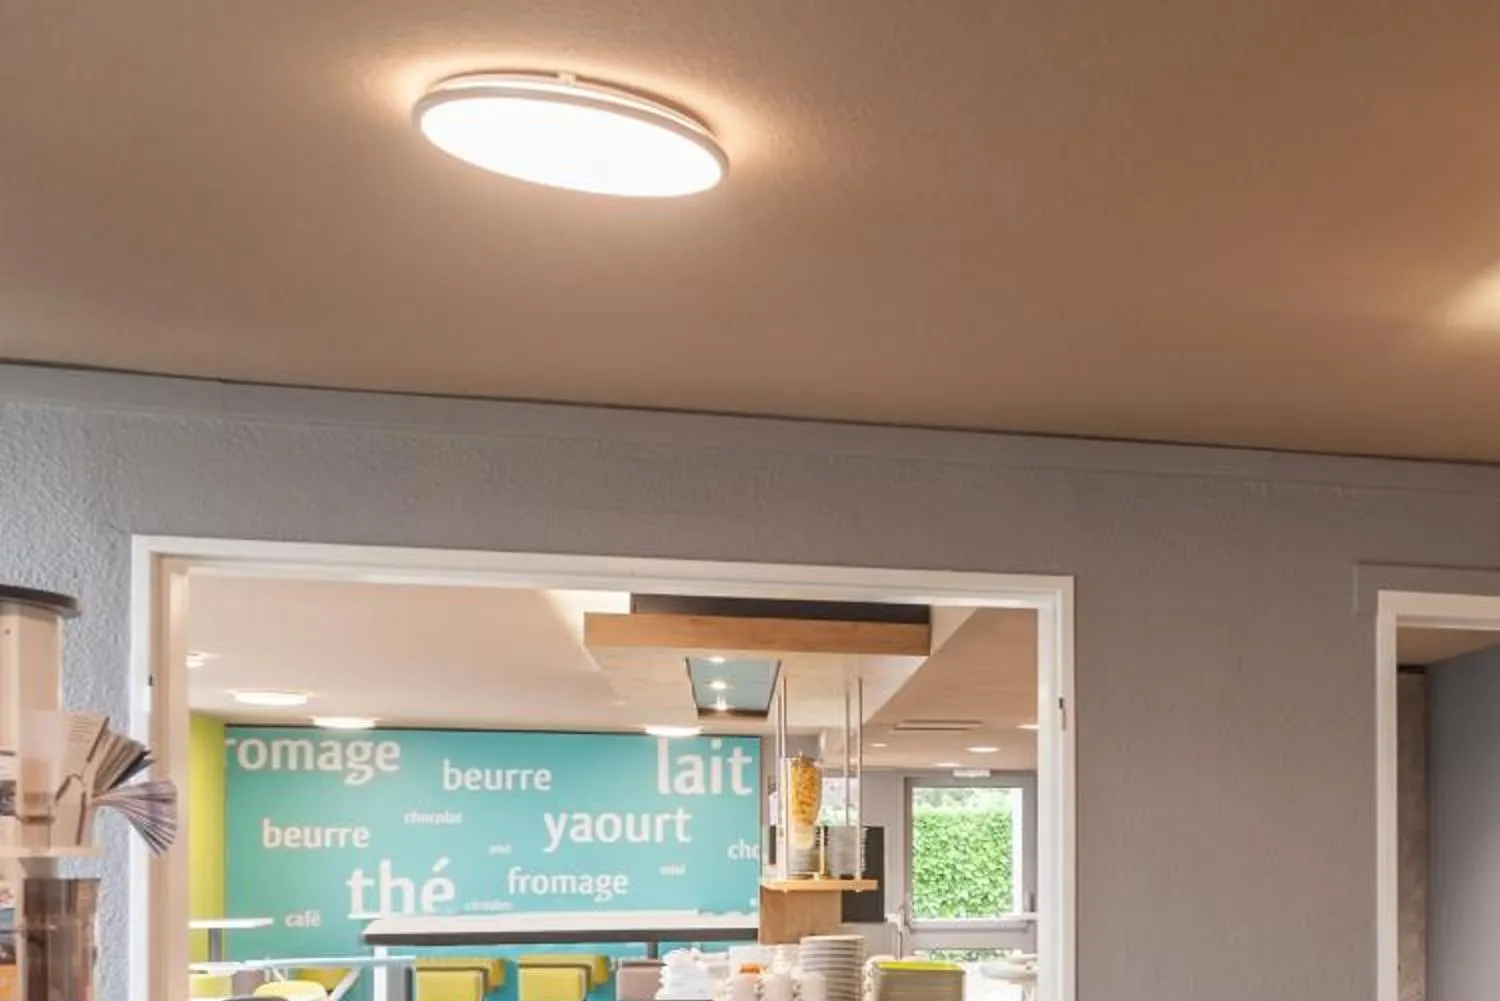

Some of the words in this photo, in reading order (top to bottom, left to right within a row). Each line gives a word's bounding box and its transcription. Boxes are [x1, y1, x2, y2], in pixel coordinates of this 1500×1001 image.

[443, 758, 552, 790] beurre
[658, 737, 753, 795] lait
[263, 817, 370, 848] beurre
[543, 807, 693, 853] yaourt
[345, 857, 456, 916] thé
[508, 865, 630, 903] fromage
[285, 909, 321, 927] café
